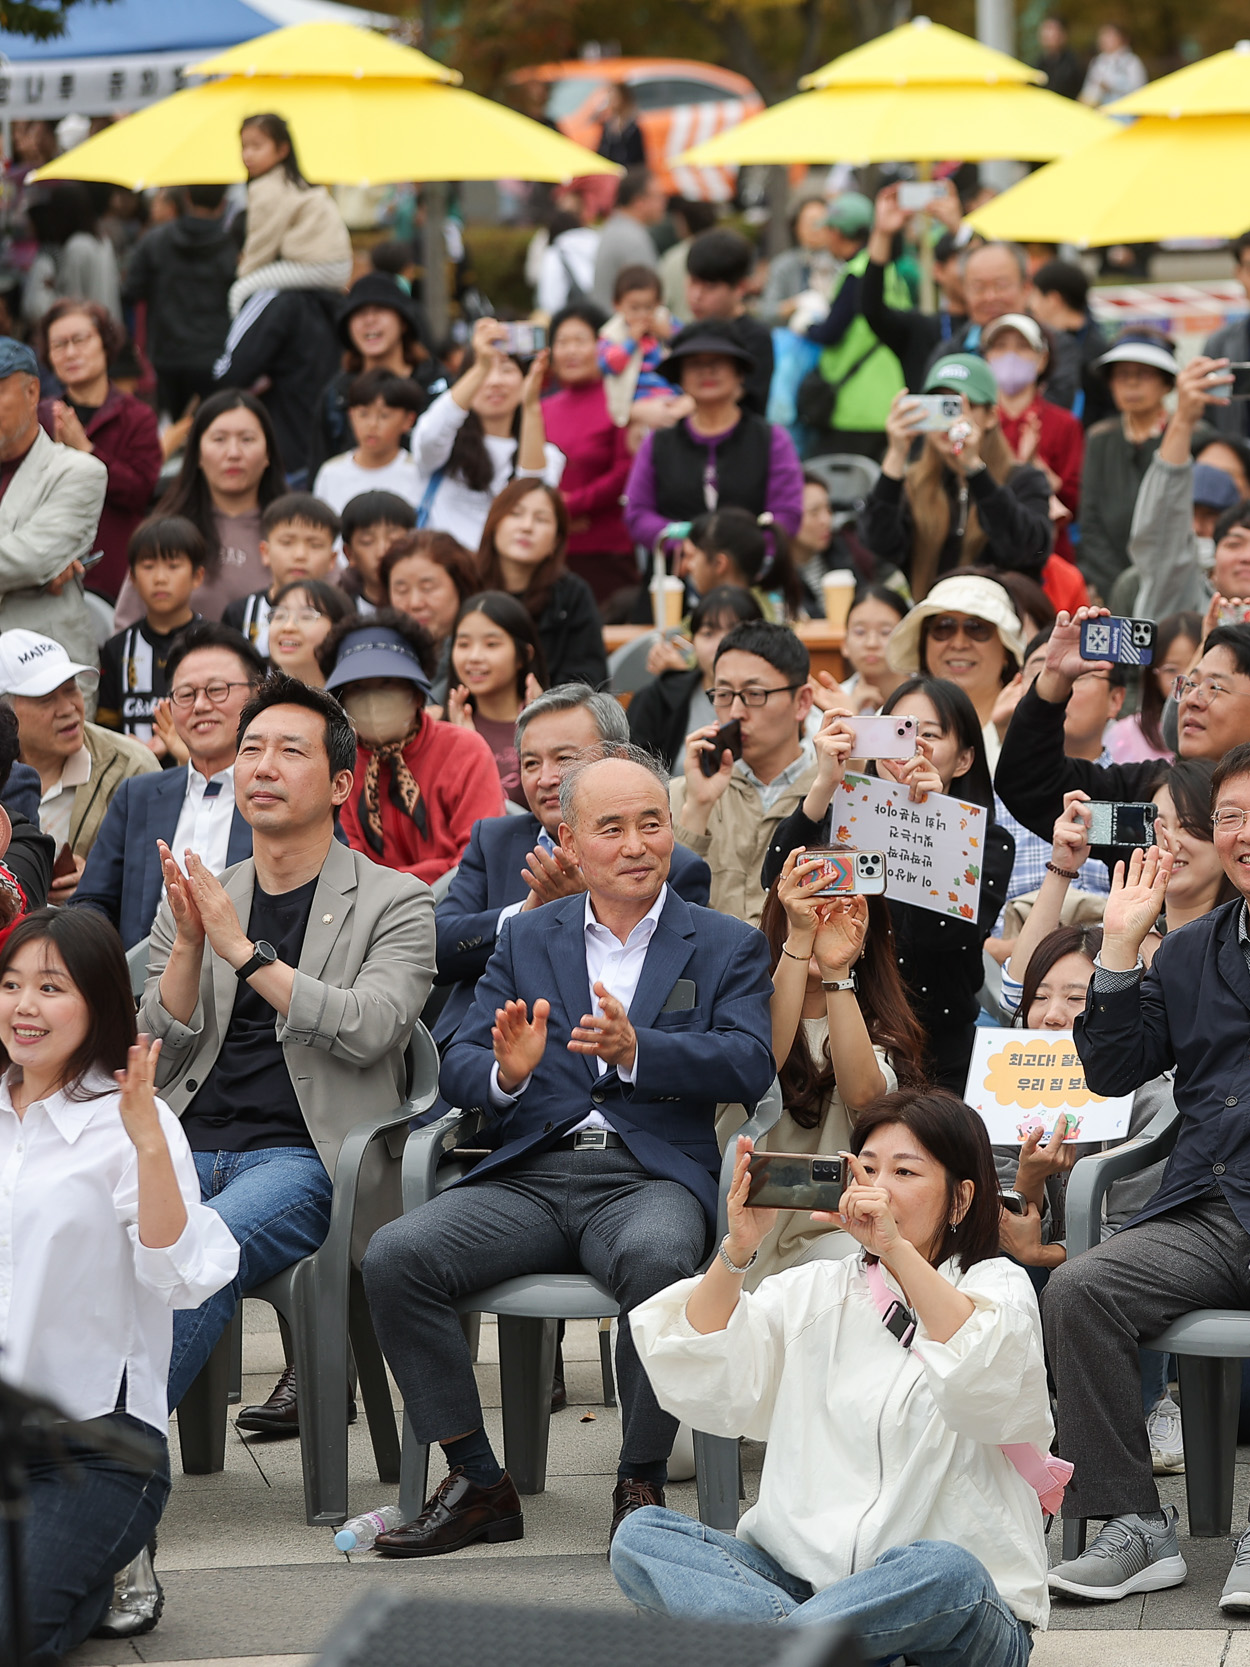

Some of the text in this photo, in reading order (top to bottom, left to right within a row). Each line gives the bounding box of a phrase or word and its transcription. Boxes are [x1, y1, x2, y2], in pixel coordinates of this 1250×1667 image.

[874, 803, 946, 831] 너희 덕분이야
[887, 846, 932, 868] 반짝반짝
[1008, 1053, 1056, 1067] 최고다!
[1017, 1078, 1045, 1091] 우리
[1050, 1078, 1064, 1091] 집
